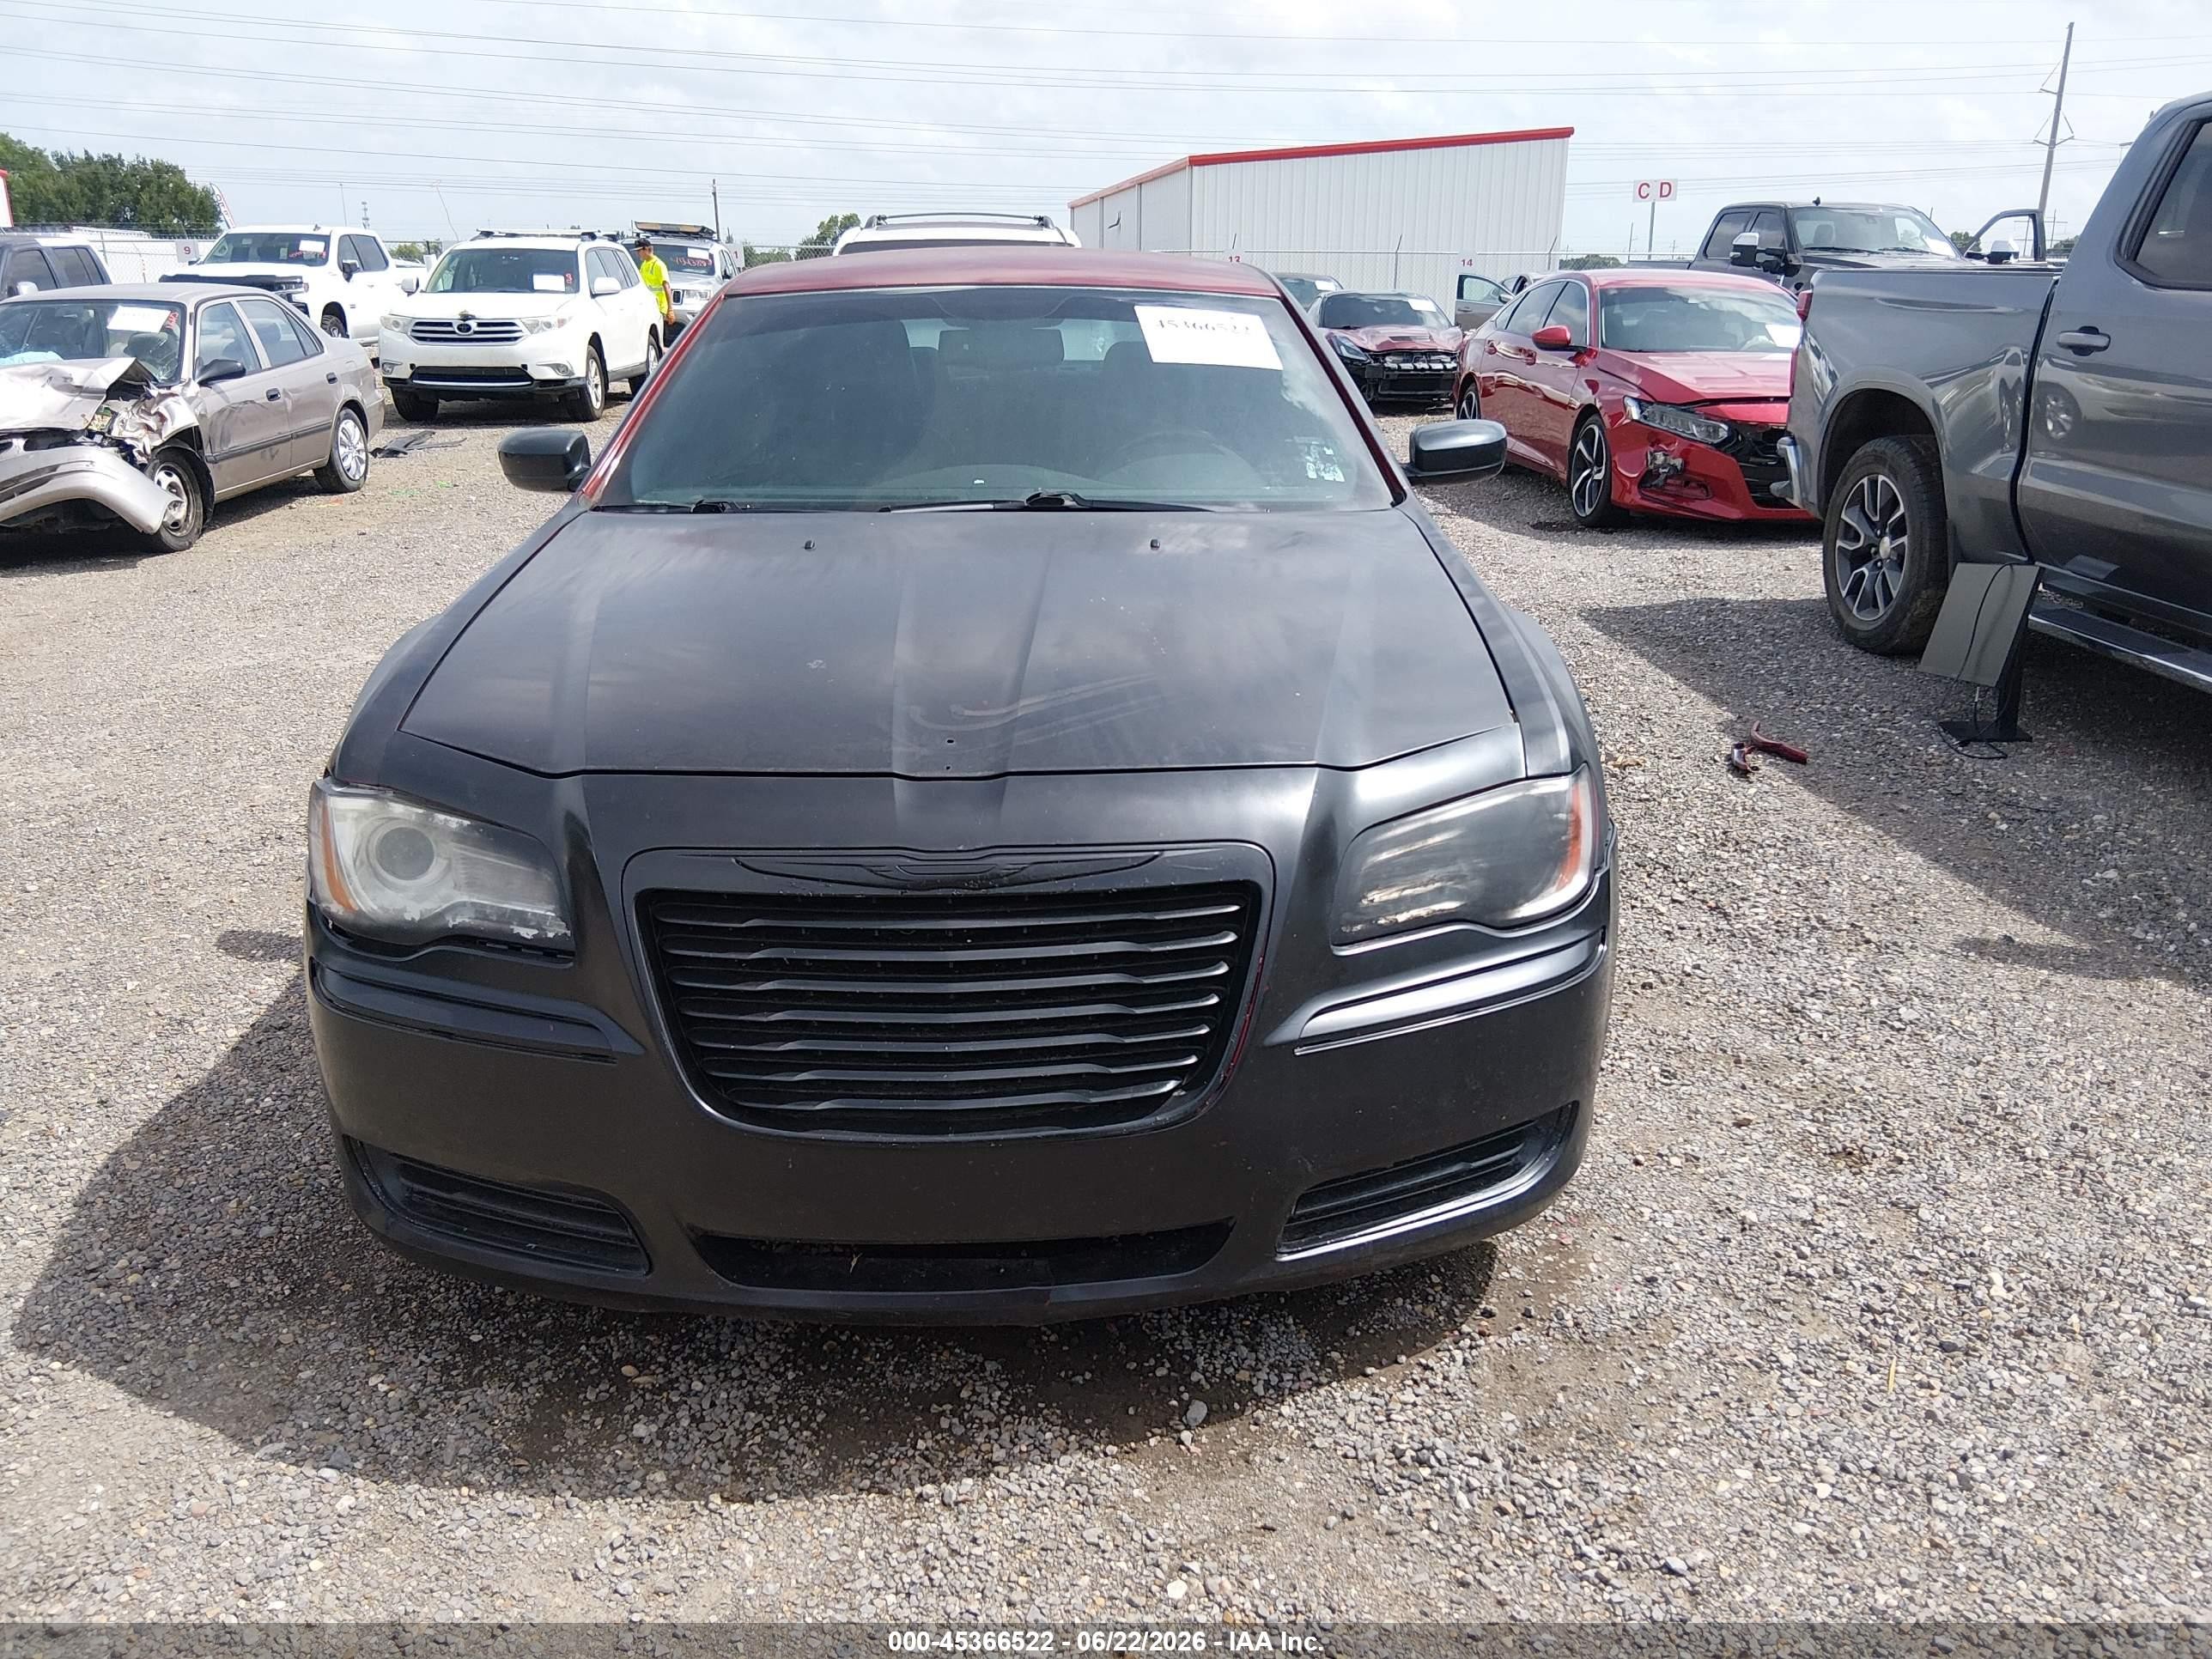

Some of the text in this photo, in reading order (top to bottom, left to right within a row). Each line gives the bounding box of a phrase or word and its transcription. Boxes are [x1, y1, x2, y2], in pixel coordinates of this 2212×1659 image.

[1638, 181, 1672, 199] C D
[183, 246, 191, 255] 9
[1461, 258, 1474, 267] 14
